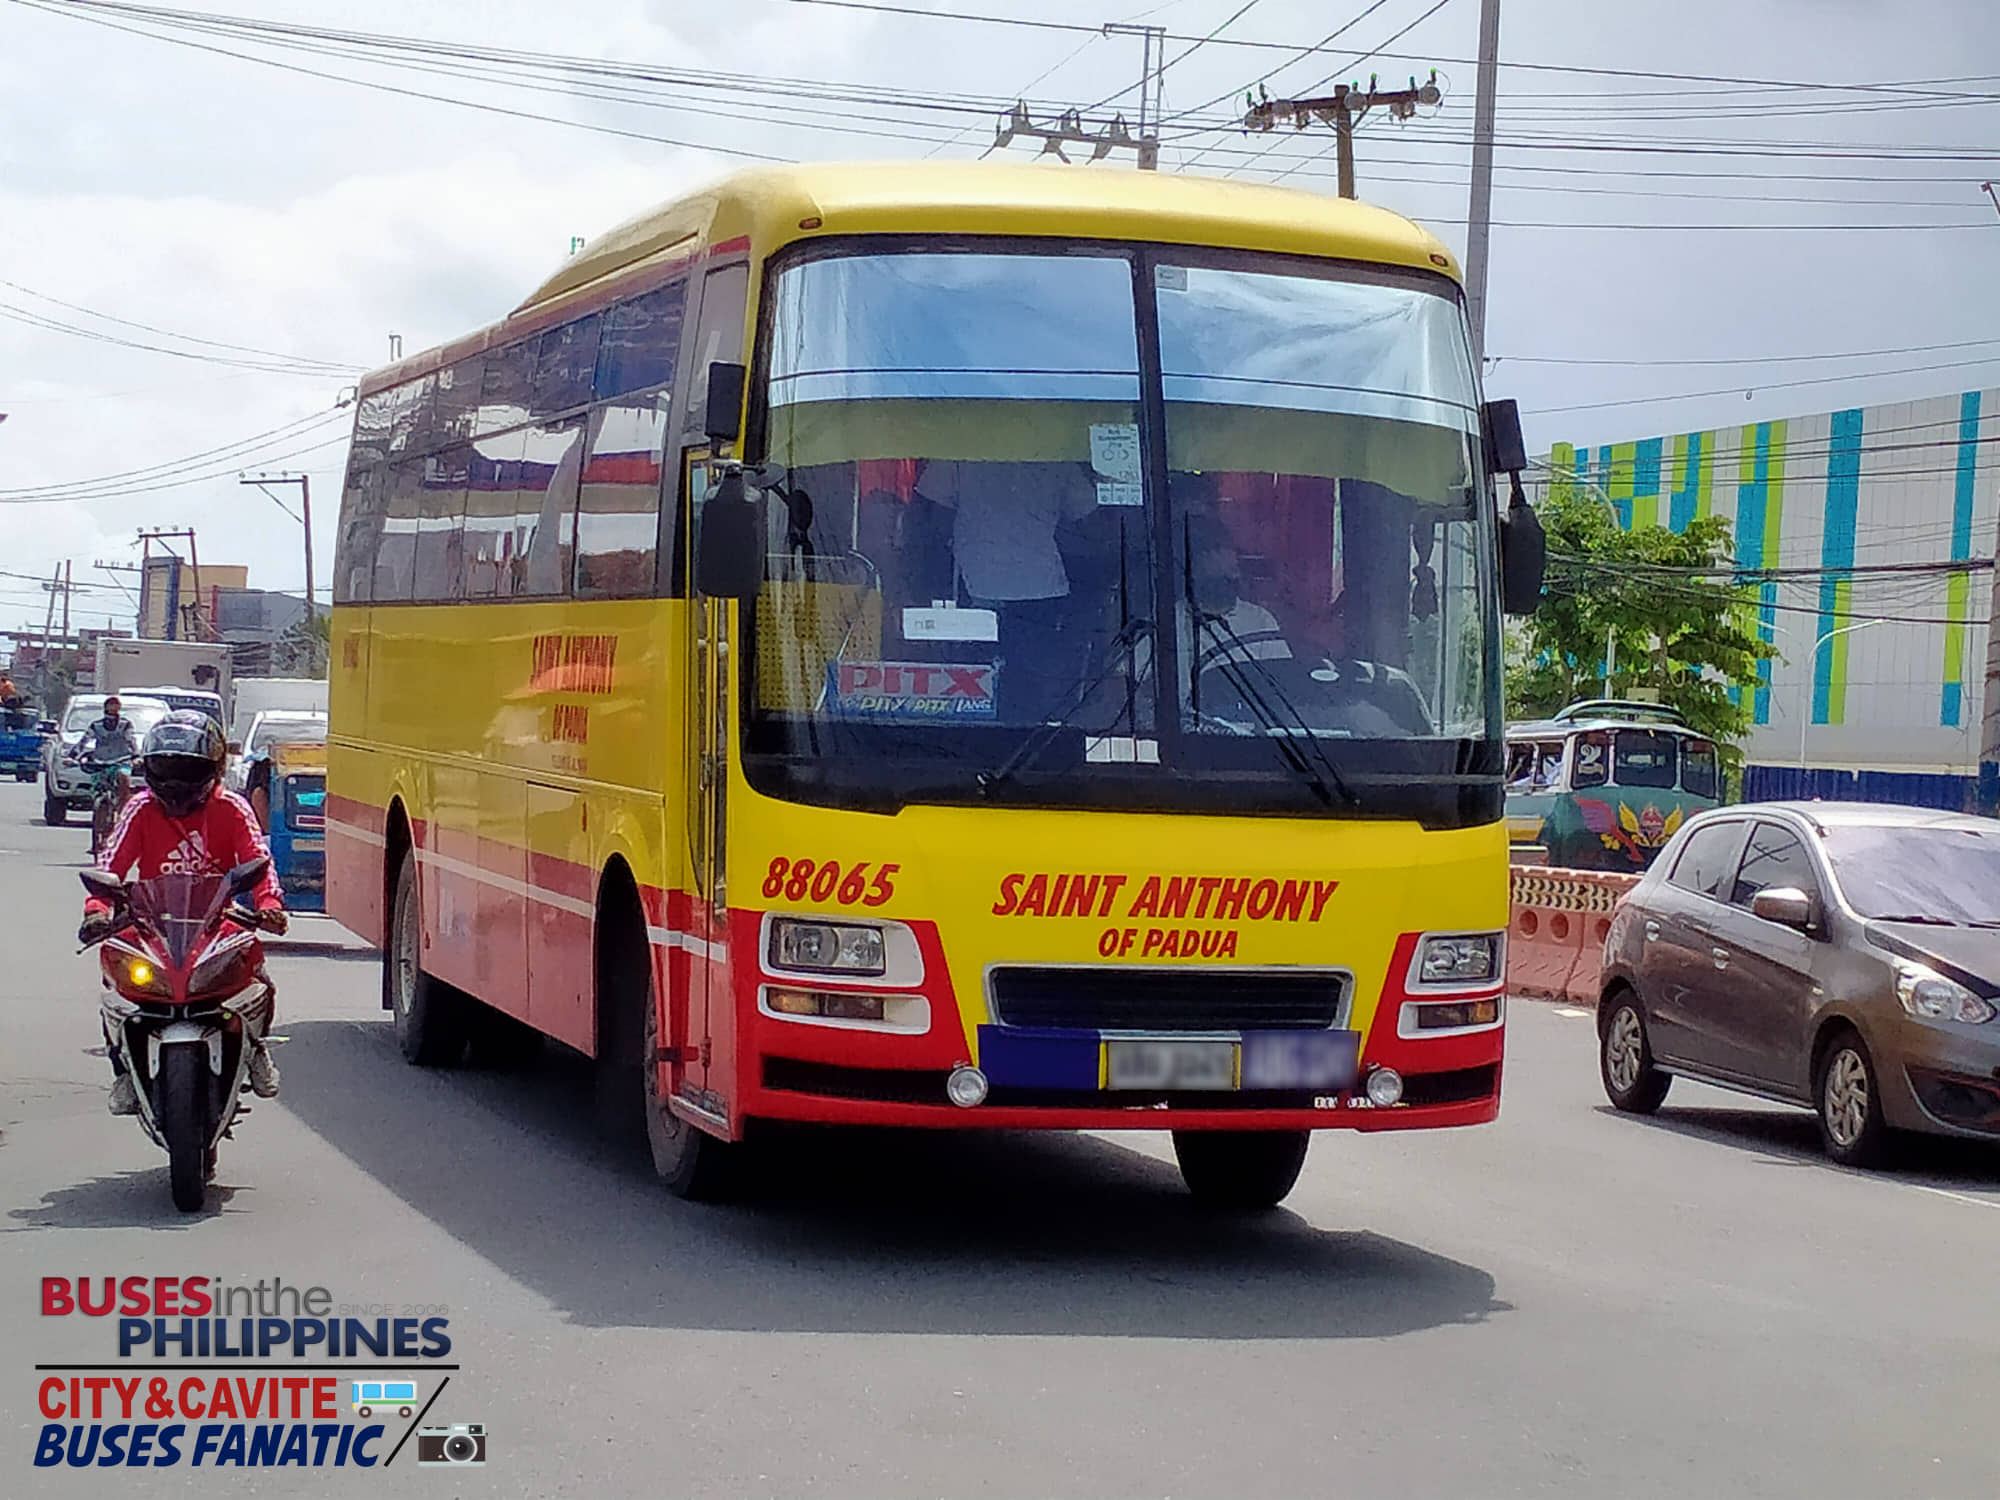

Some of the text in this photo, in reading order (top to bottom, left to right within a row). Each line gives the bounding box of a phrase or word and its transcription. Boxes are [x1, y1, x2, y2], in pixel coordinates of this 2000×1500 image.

[839, 664, 991, 698] PITX
[762, 857, 901, 907] 88065
[992, 873, 1340, 922] SAINT ANTHONY
[1098, 929, 1238, 958] OF PADUA
